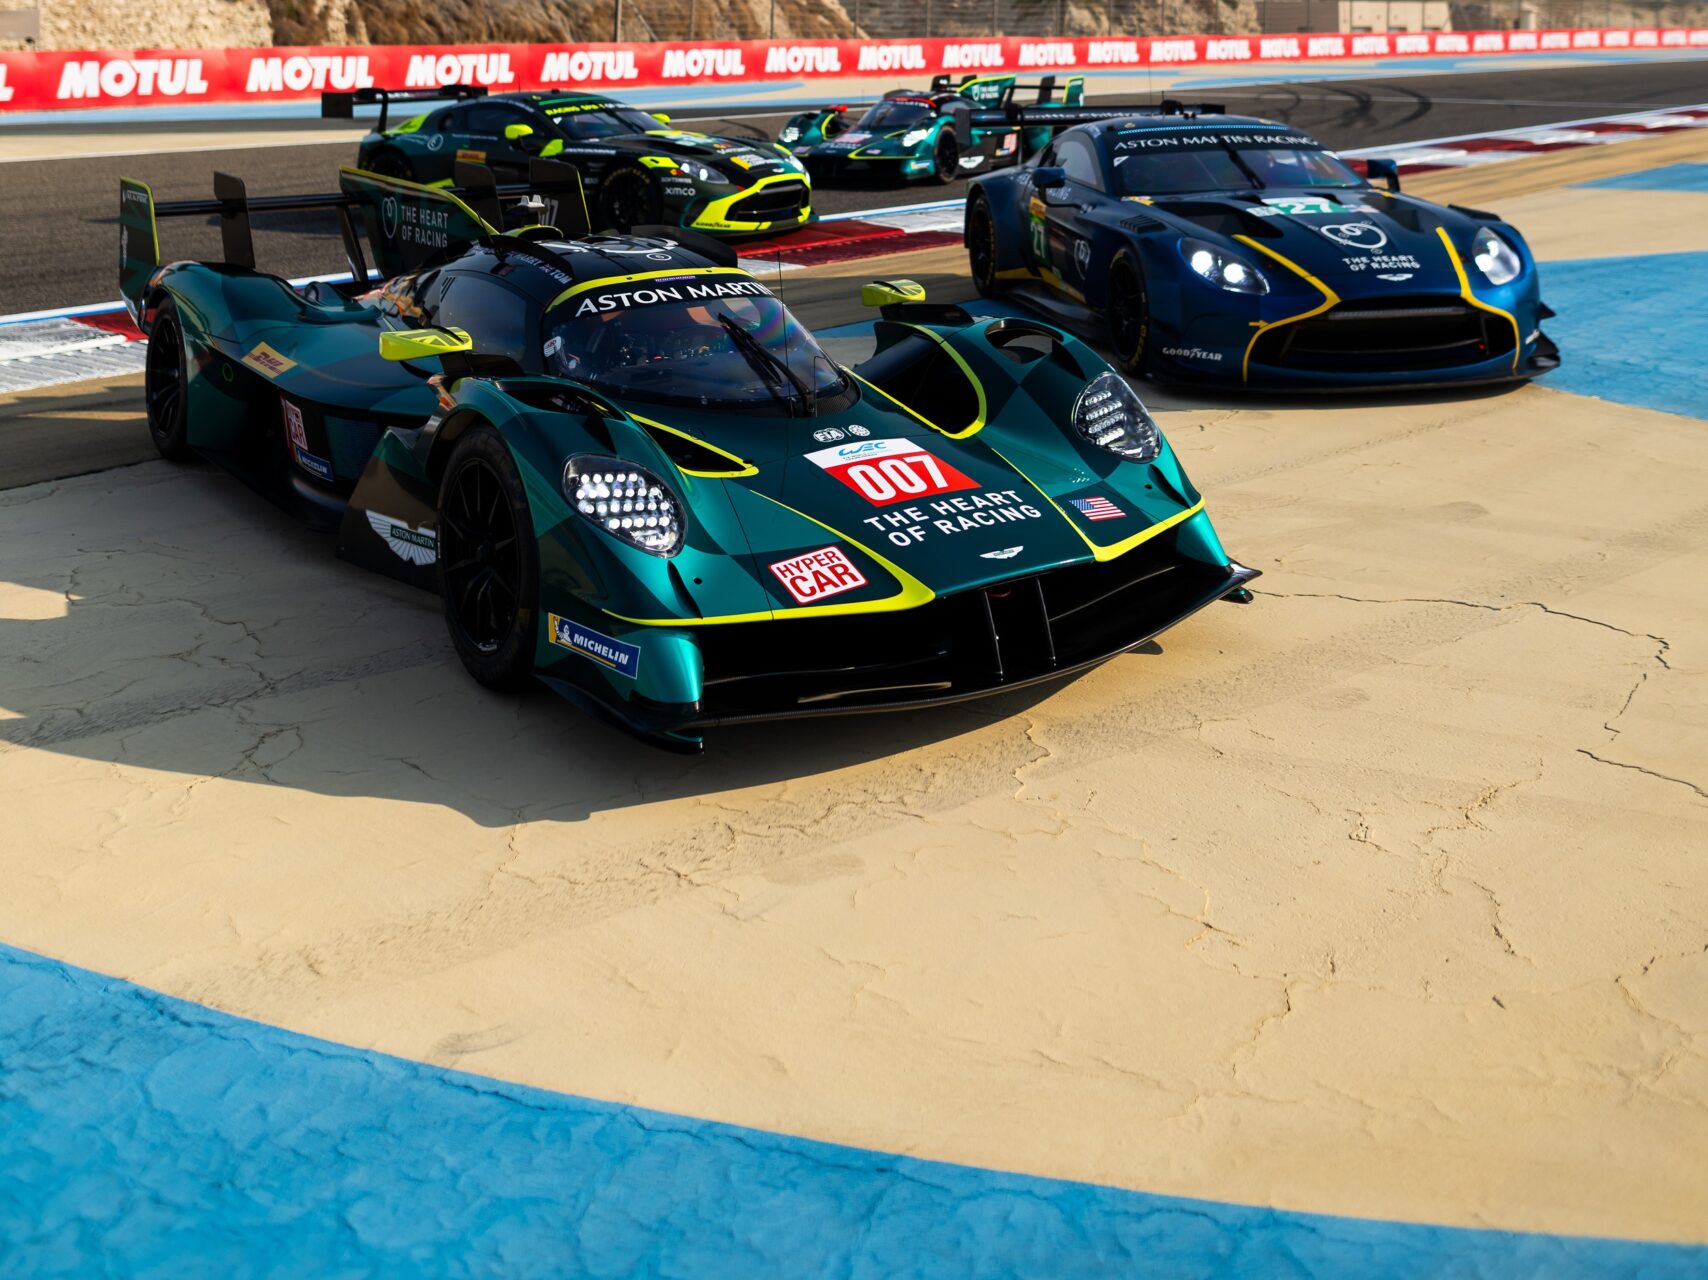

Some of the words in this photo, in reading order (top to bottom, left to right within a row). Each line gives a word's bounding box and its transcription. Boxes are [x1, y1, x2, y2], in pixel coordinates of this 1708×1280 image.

[57, 61, 208, 99] MOTUL
[246, 56, 374, 92] MOTUL
[405, 53, 514, 86] MOTUL
[541, 51, 638, 81] MOTUL
[662, 49, 745, 77] MOTUL
[765, 46, 841, 73] MOTUL
[858, 45, 925, 71] MOTUL
[942, 43, 1004, 68] MOTUL
[1019, 43, 1077, 66] MOTUL
[1088, 41, 1140, 63] MOTUL
[1150, 40, 1198, 61] MOTUL
[1206, 39, 1251, 60] MOTUL
[1114, 136, 1178, 151] ASTON
[665, 186, 696, 197] xmco
[401, 205, 418, 222] THE
[419, 209, 449, 229] HEART
[1277, 200, 1333, 215] 27
[401, 228, 413, 241] OF
[414, 230, 448, 248] RACING
[1030, 222, 1046, 259] 27
[1342, 256, 1370, 265] THE
[1372, 254, 1415, 263] HEART
[1350, 263, 1368, 271] OF
[1371, 261, 1420, 270] RACING
[575, 287, 687, 317] ASTON
[689, 281, 775, 298] MARTIN
[1162, 347, 1222, 361] GOODYEAR
[838, 441, 887, 457] WEC
[847, 455, 950, 501] 007
[863, 506, 929, 532] THE
[930, 490, 1025, 516] HEART
[391, 527, 411, 541] ASTON
[411, 533, 435, 548] MARTIN
[888, 526, 926, 547] OF
[932, 504, 1042, 535] RACING
[775, 550, 843, 579] HYPER
[788, 563, 860, 598] CAR
[573, 633, 629, 665] MICHELIN
